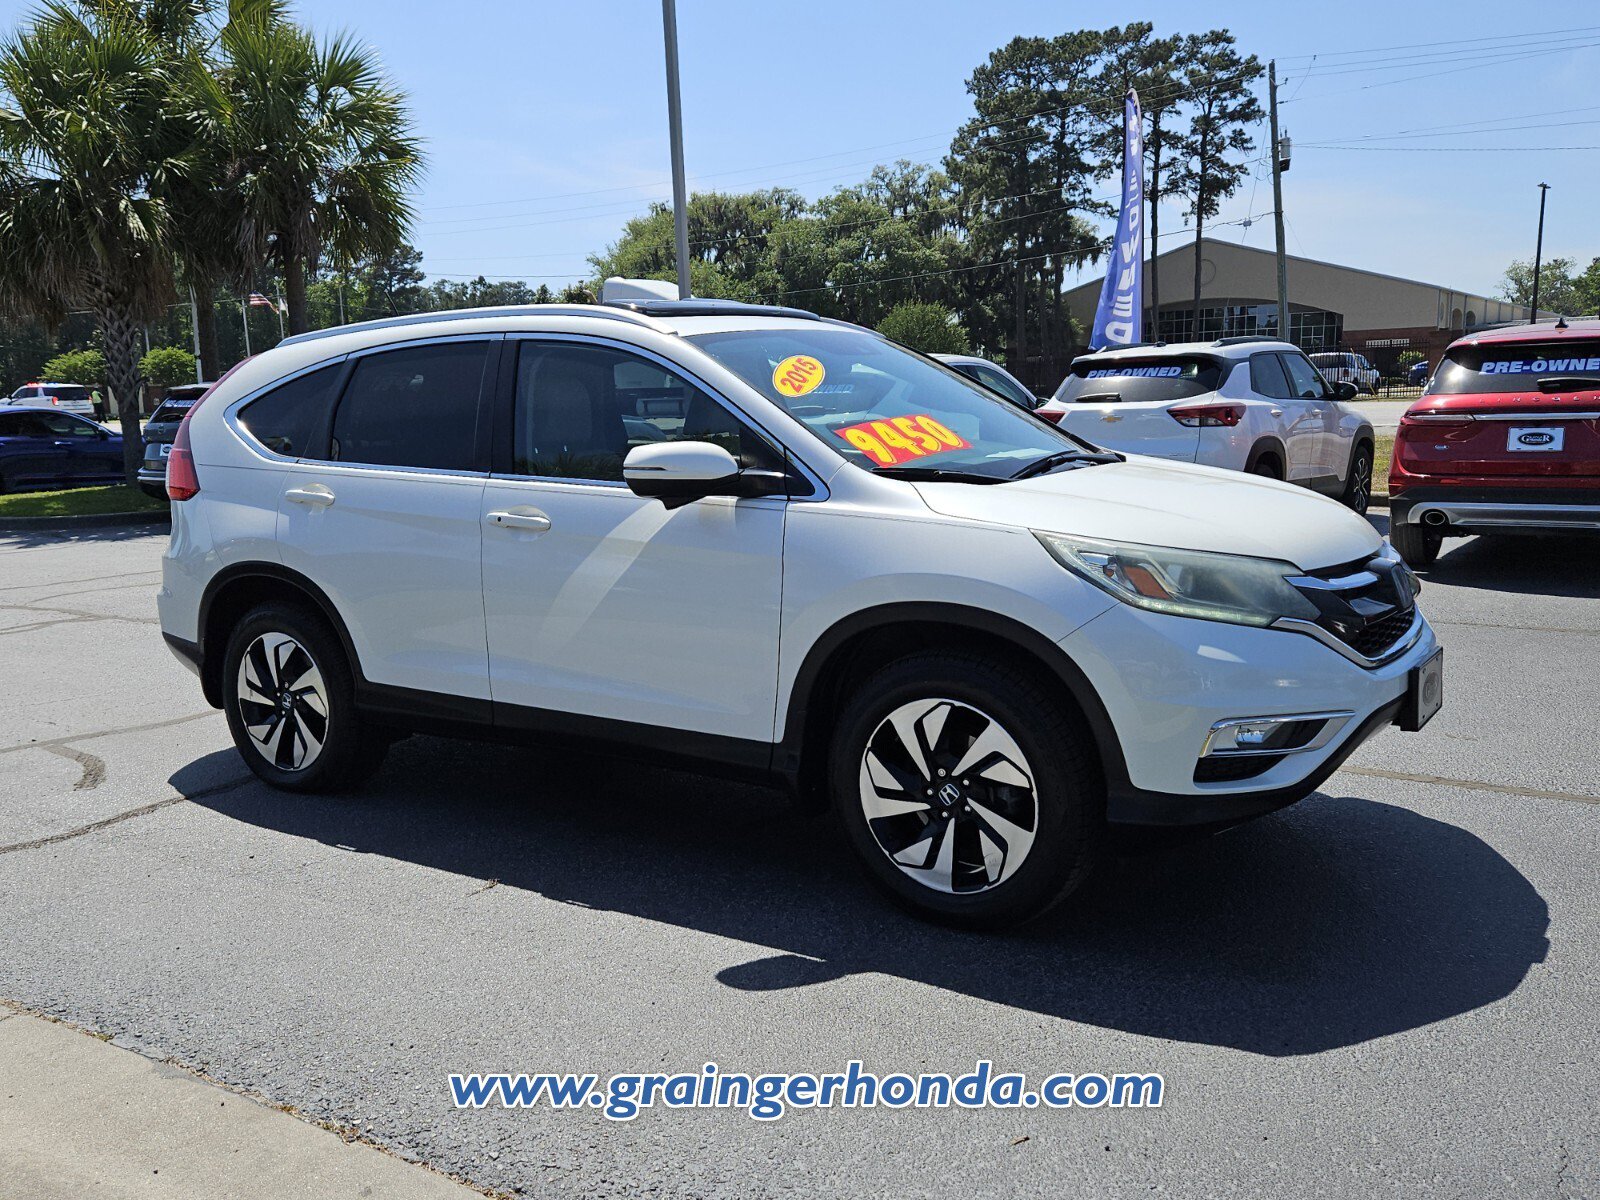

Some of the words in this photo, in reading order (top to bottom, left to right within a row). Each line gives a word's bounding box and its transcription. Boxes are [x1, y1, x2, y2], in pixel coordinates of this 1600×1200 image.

[780, 357, 818, 393] 2015
[1088, 367, 1181, 379] PRE-OWNED
[845, 415, 965, 463] 9450
